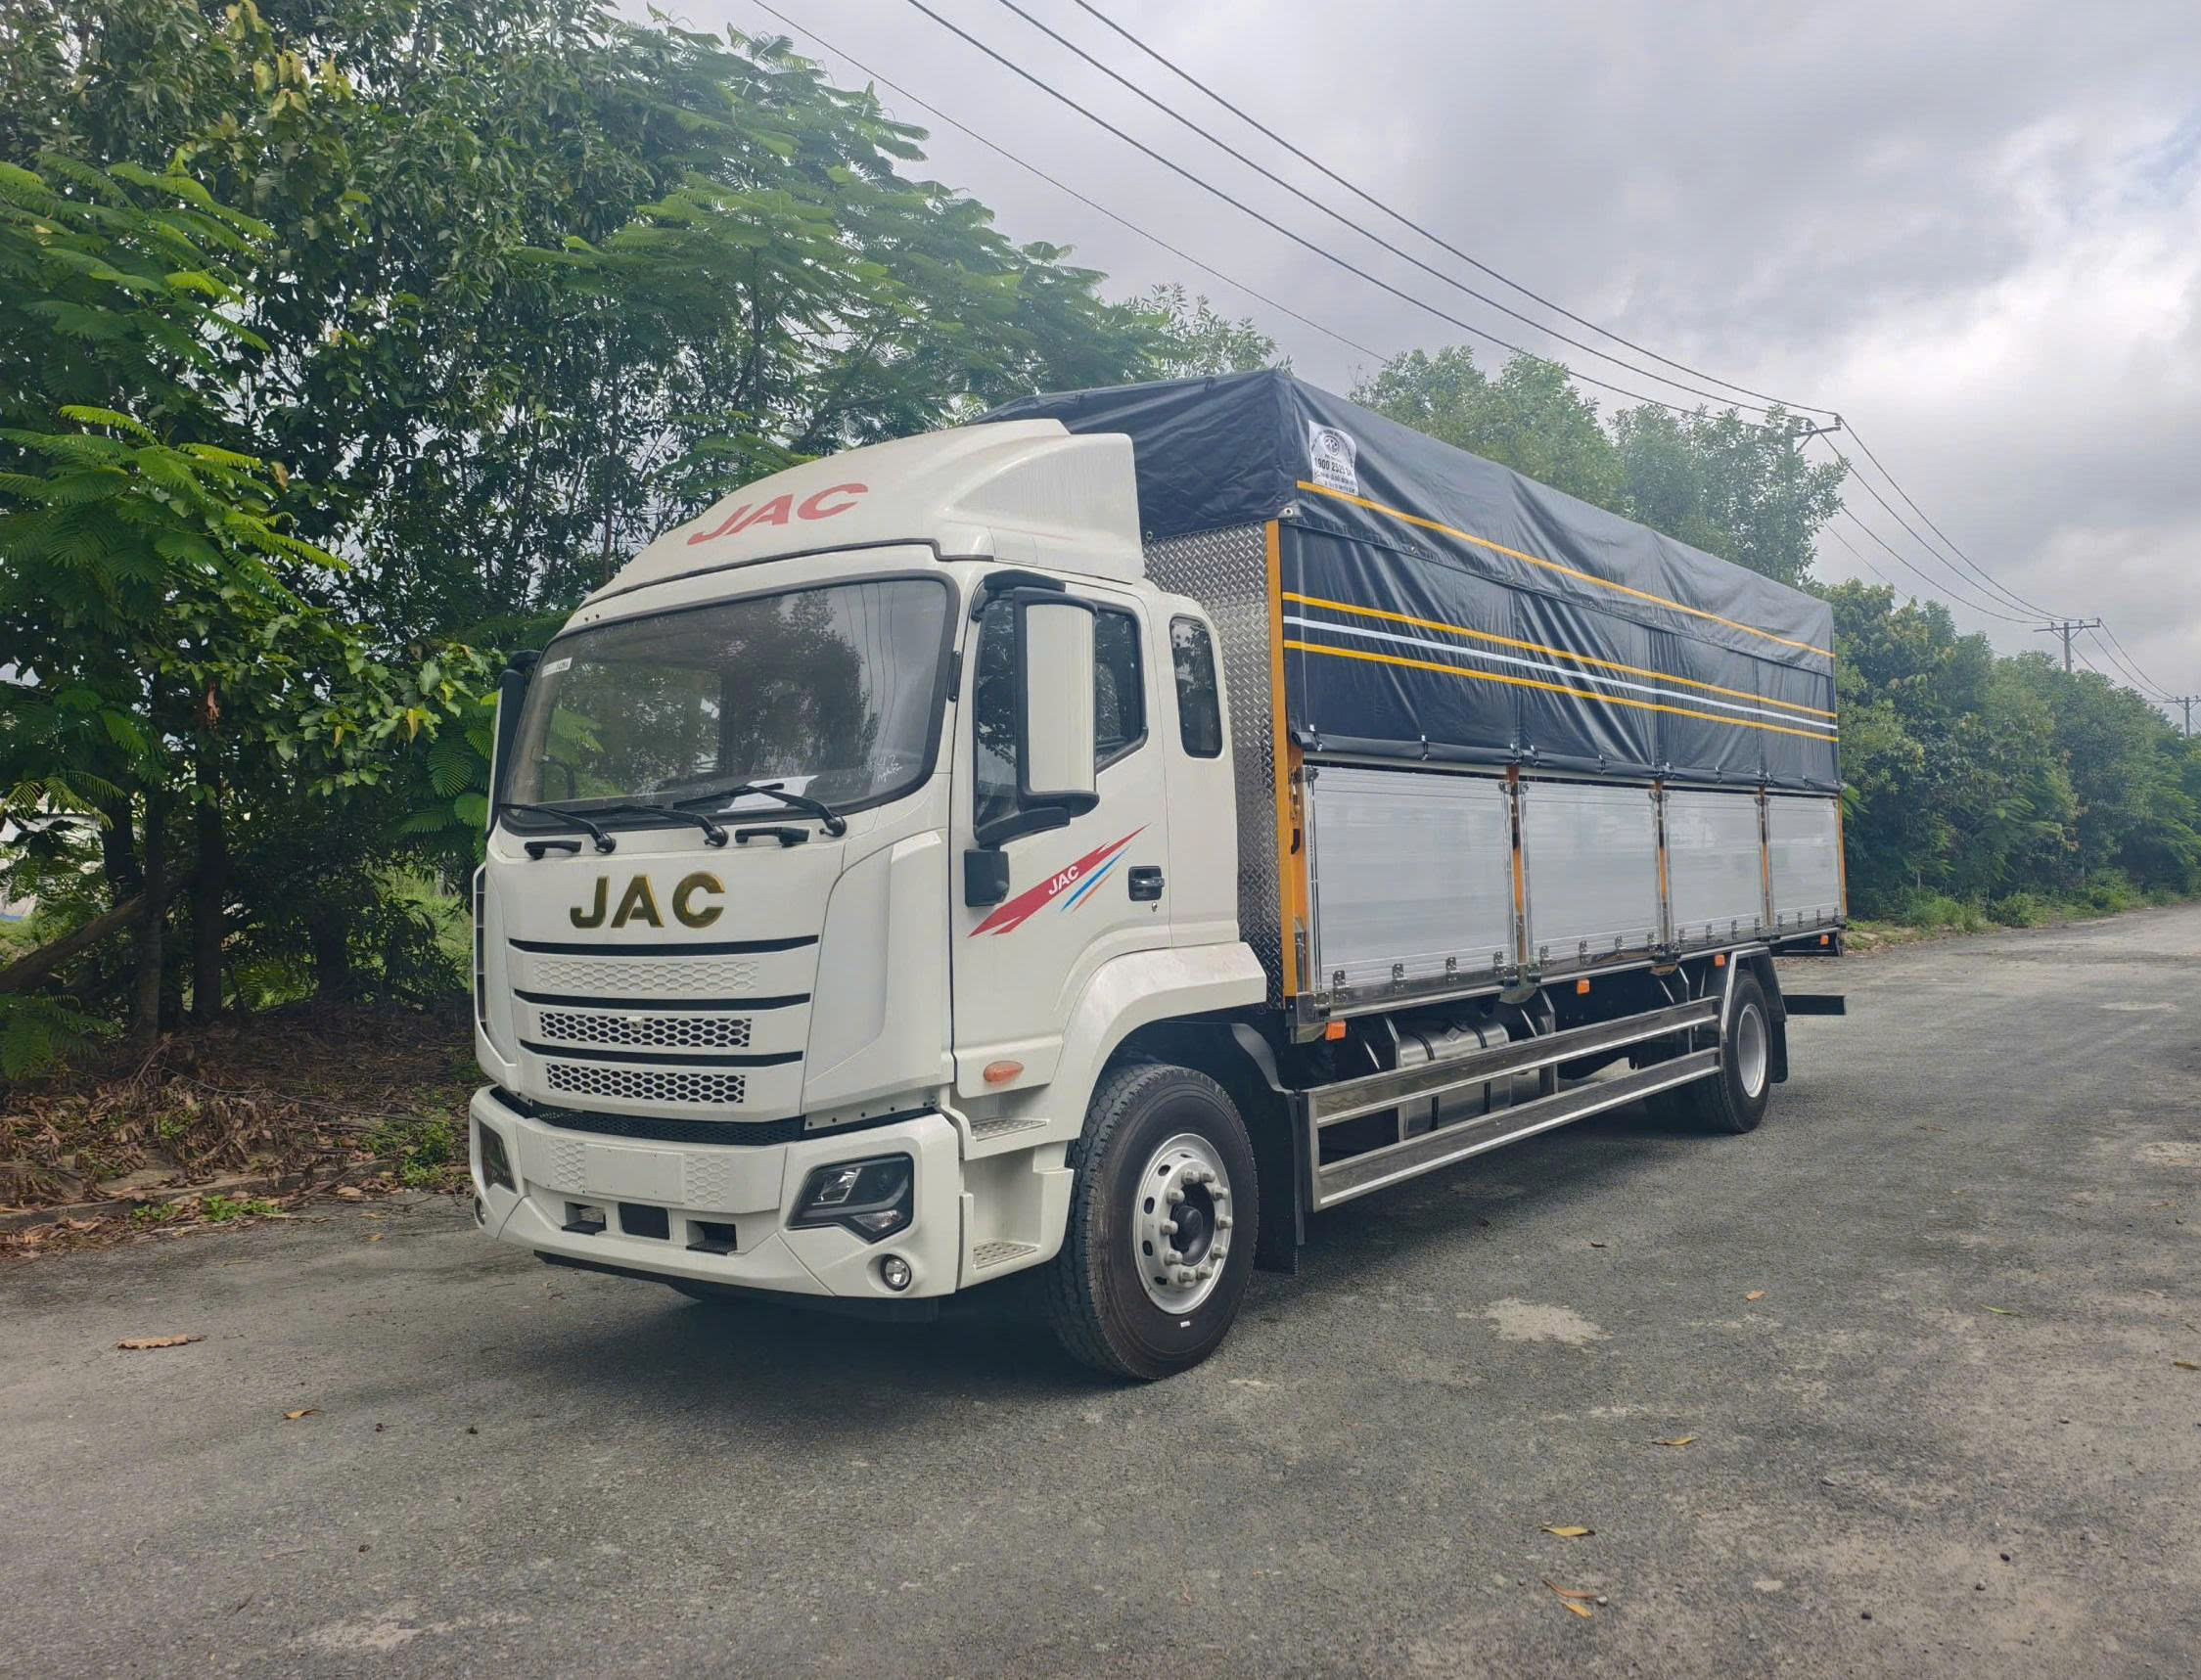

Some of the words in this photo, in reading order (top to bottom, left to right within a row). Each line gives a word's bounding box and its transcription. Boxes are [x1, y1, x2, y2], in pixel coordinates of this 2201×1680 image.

[687, 482, 868, 545] JAC
[571, 871, 725, 929] JAC
[1048, 866, 1079, 895] JAC
